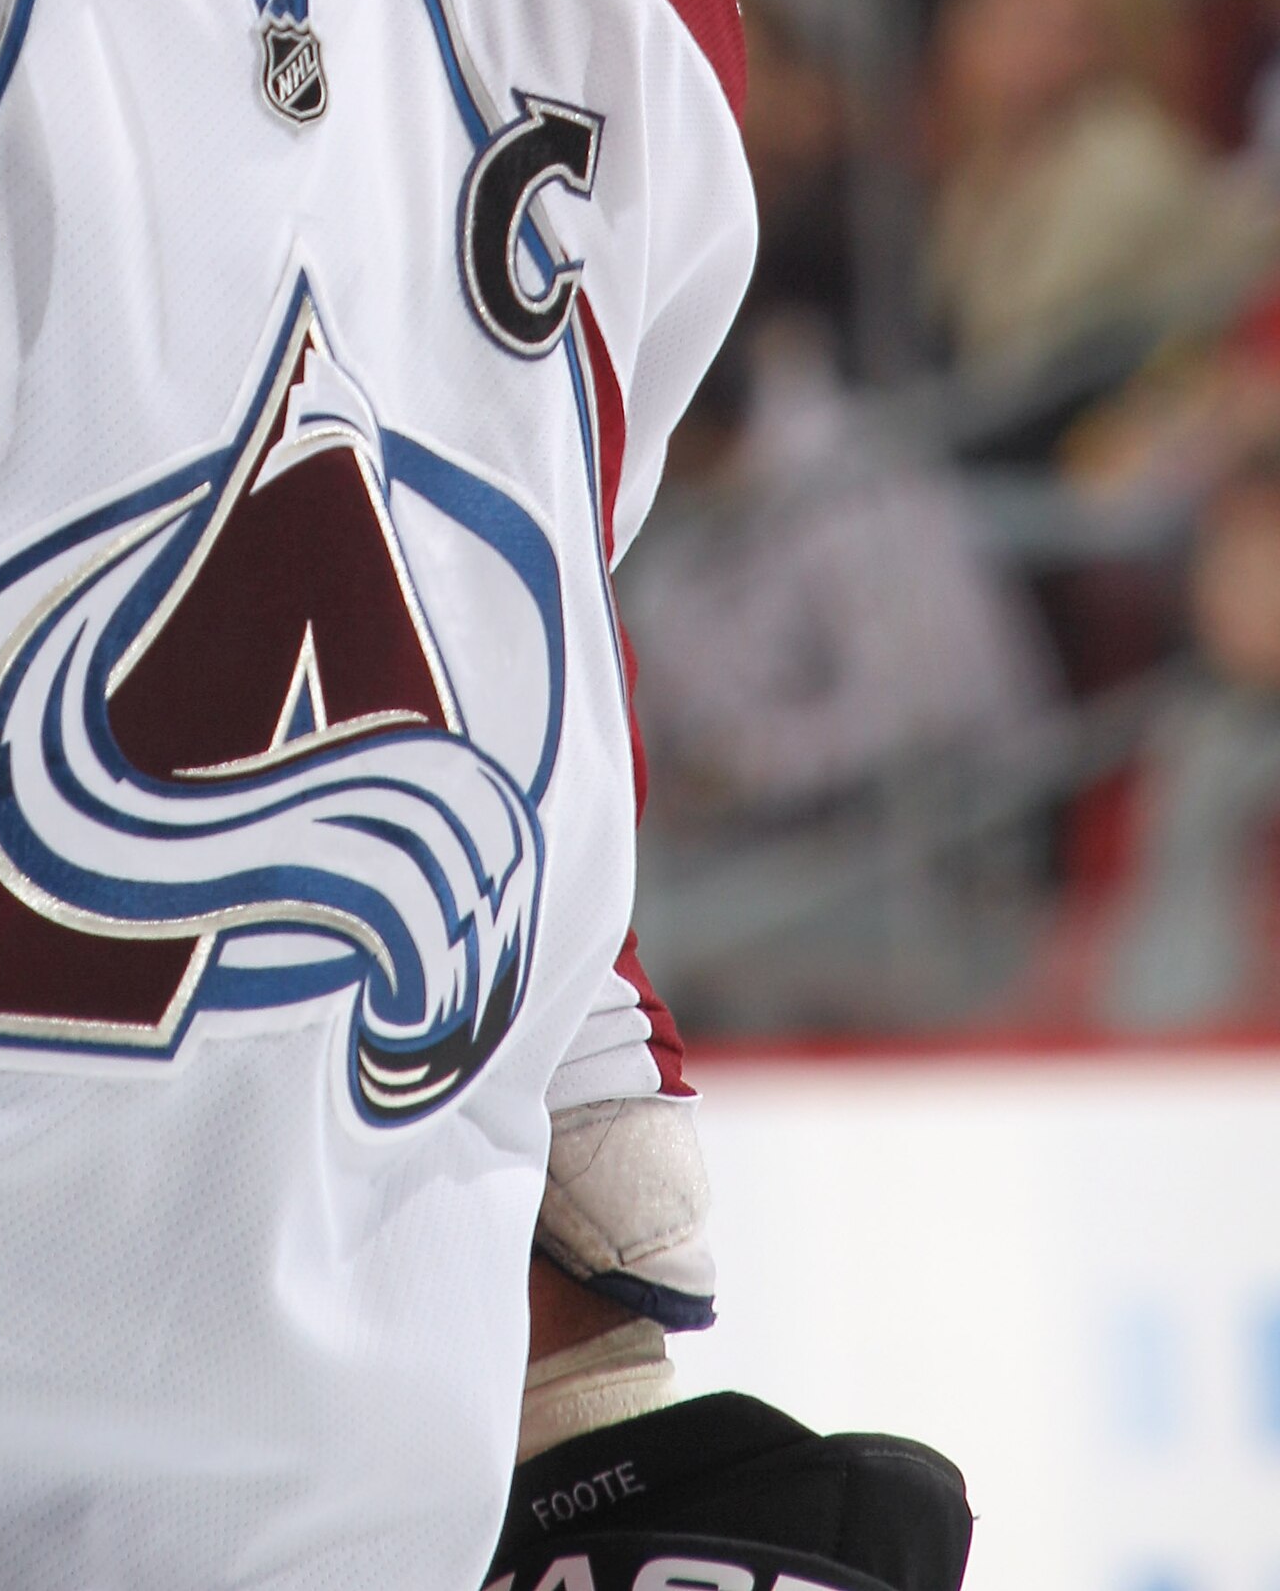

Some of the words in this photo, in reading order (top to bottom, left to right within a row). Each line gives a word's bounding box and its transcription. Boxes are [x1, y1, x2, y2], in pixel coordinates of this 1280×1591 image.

[277, 46, 318, 104] NHL
[455, 86, 606, 362] C
[531, 1460, 647, 1531] FOOTE
